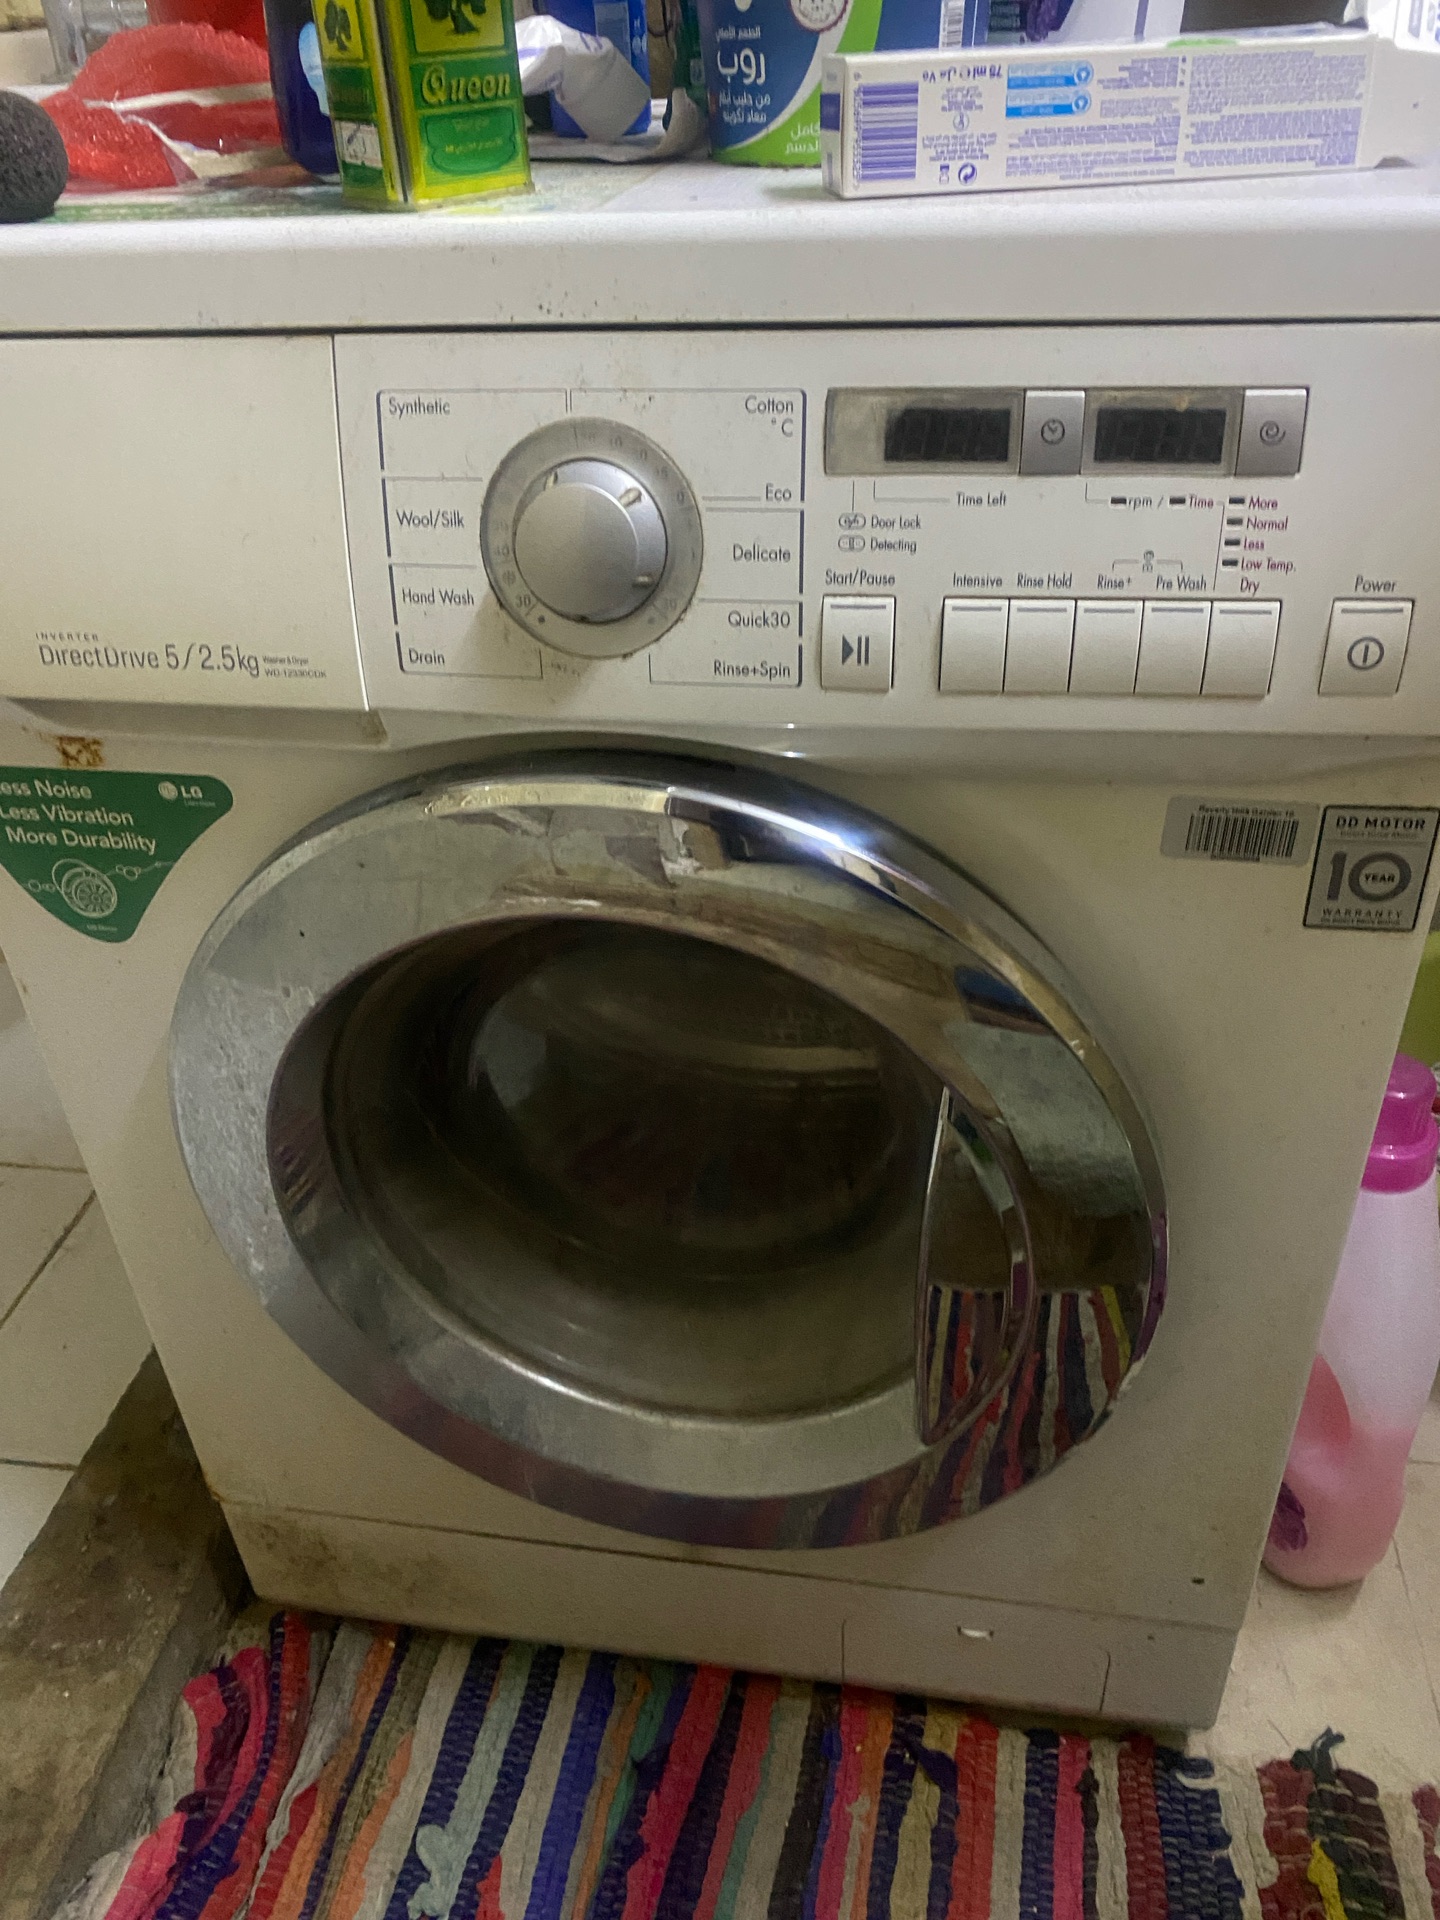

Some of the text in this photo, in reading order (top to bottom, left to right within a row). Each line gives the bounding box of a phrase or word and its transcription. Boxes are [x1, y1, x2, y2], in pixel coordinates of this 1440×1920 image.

[717, 48, 766, 85] روب
[421, 64, 511, 105] Queen
[389, 396, 451, 419] Synthetic
[745, 394, 794, 414] Cotton
[765, 482, 792, 502] Eco
[956, 490, 1007, 507] Time Left
[1128, 495, 1153, 511] rpm
[1189, 493, 1214, 509] Time
[1248, 495, 1278, 510] More
[395, 508, 465, 529] Wool/Silk
[871, 514, 921, 530] Door Lock
[1246, 515, 1289, 532] Normal
[870, 537, 917, 555] Detecting
[1243, 536, 1265, 550] Less
[733, 543, 791, 563] Delicate
[1241, 556, 1296, 575] Low Temp.
[825, 567, 896, 586] Start/Pause
[953, 572, 1003, 588] Intensive
[1017, 572, 1072, 589] Rinse Hold
[1156, 574, 1207, 591] Pre Wash
[1240, 576, 1260, 596] Dry
[1354, 575, 1397, 593] Power
[402, 587, 474, 606] Hand Wash
[728, 609, 791, 629] Quick30
[408, 647, 445, 665] Drain
[714, 660, 791, 681] Rinse+Spin
[0, 778, 92, 800] ess Noise
[180, 785, 203, 799] LG
[42, 804, 135, 827] Vibration
[1335, 815, 1426, 831] DD MOTOR
[5, 826, 157, 856] More Durability
[1327, 851, 1412, 902] 10
[1364, 872, 1395, 884] YEAR
[1322, 907, 1402, 919] WARRANTY
